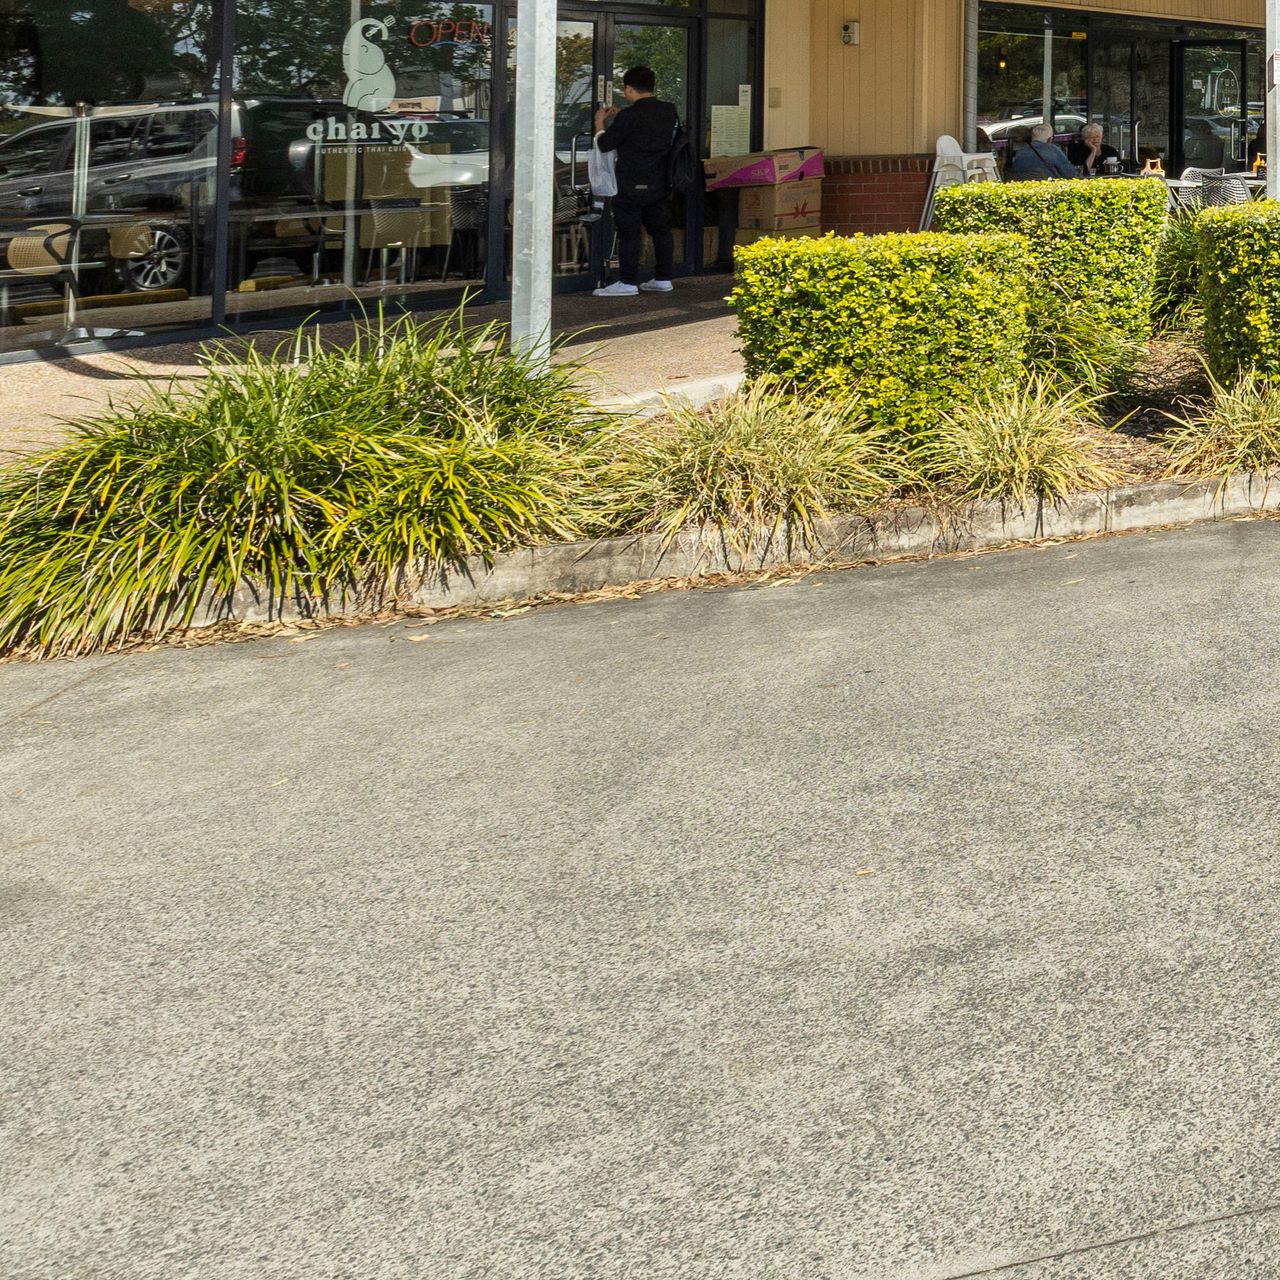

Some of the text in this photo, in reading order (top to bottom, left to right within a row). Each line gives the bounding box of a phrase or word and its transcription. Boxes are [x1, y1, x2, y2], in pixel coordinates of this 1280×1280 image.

[410, 19, 488, 47] OPEN
[306, 116, 429, 144] chai yo
